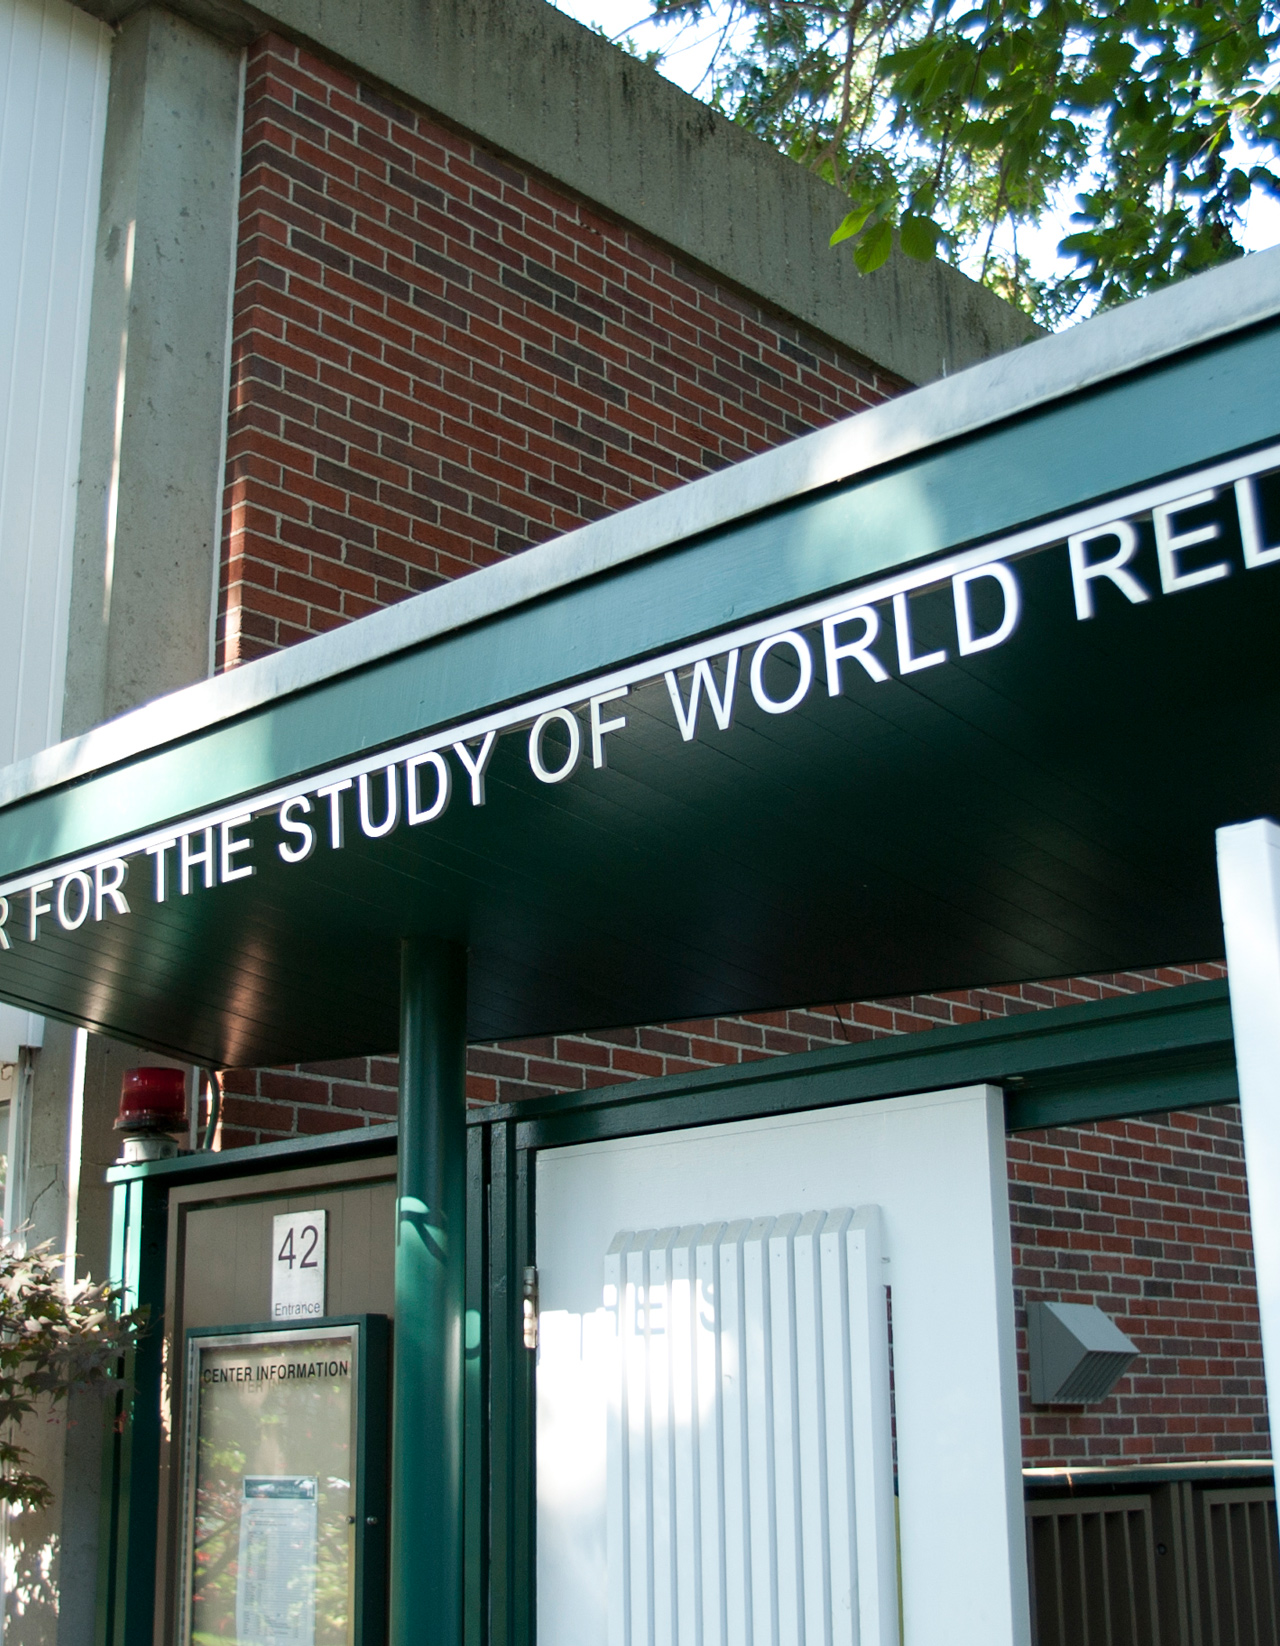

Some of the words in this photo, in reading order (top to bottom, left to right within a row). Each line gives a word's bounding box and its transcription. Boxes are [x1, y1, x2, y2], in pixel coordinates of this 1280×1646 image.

[30, 858, 131, 942] FOR
[146, 813, 256, 903] THE
[278, 730, 496, 863] STUDY
[527, 686, 630, 784] OF
[664, 562, 1021, 741] WORLD
[278, 1225, 318, 1269] 42
[275, 1301, 321, 1317] Entrance
[203, 1366, 253, 1384] CENTER
[256, 1360, 349, 1381] INFORMATION
